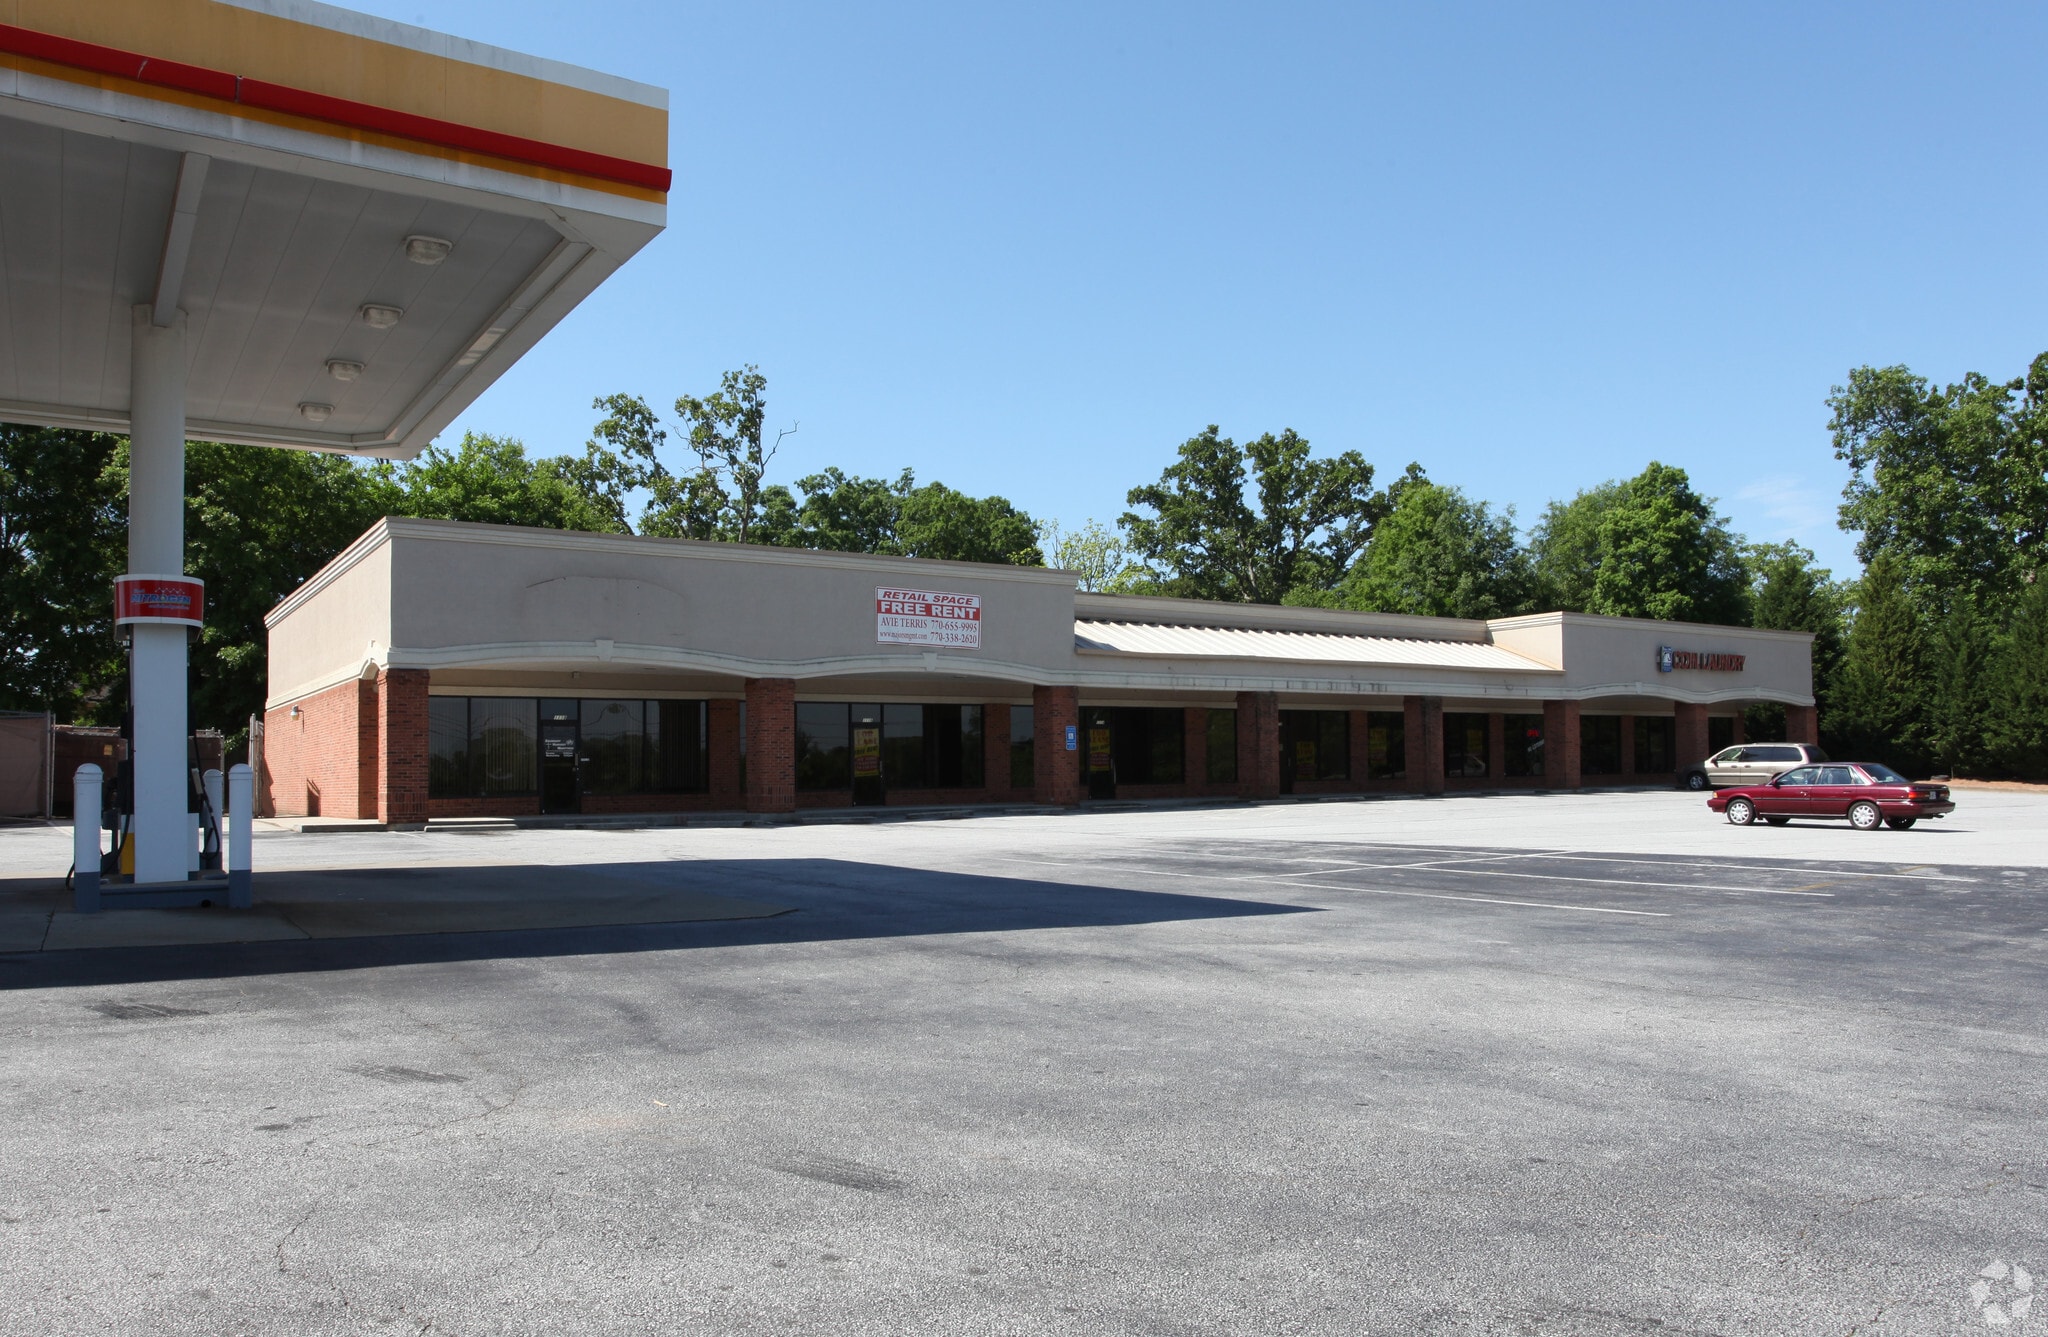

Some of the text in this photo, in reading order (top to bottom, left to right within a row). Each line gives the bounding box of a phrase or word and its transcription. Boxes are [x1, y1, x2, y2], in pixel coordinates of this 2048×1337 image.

[131, 594, 191, 605] NITROGEN
[882, 591, 973, 605] RETAIL SPACE
[881, 602, 976, 618] FREE RENT
[881, 617, 977, 633] AVIE TERRIS 770-655-9995
[930, 631, 977, 644] 770-338-2620
[1673, 651, 1698, 669] COIN
[1700, 653, 1746, 671] LAUNDRY
